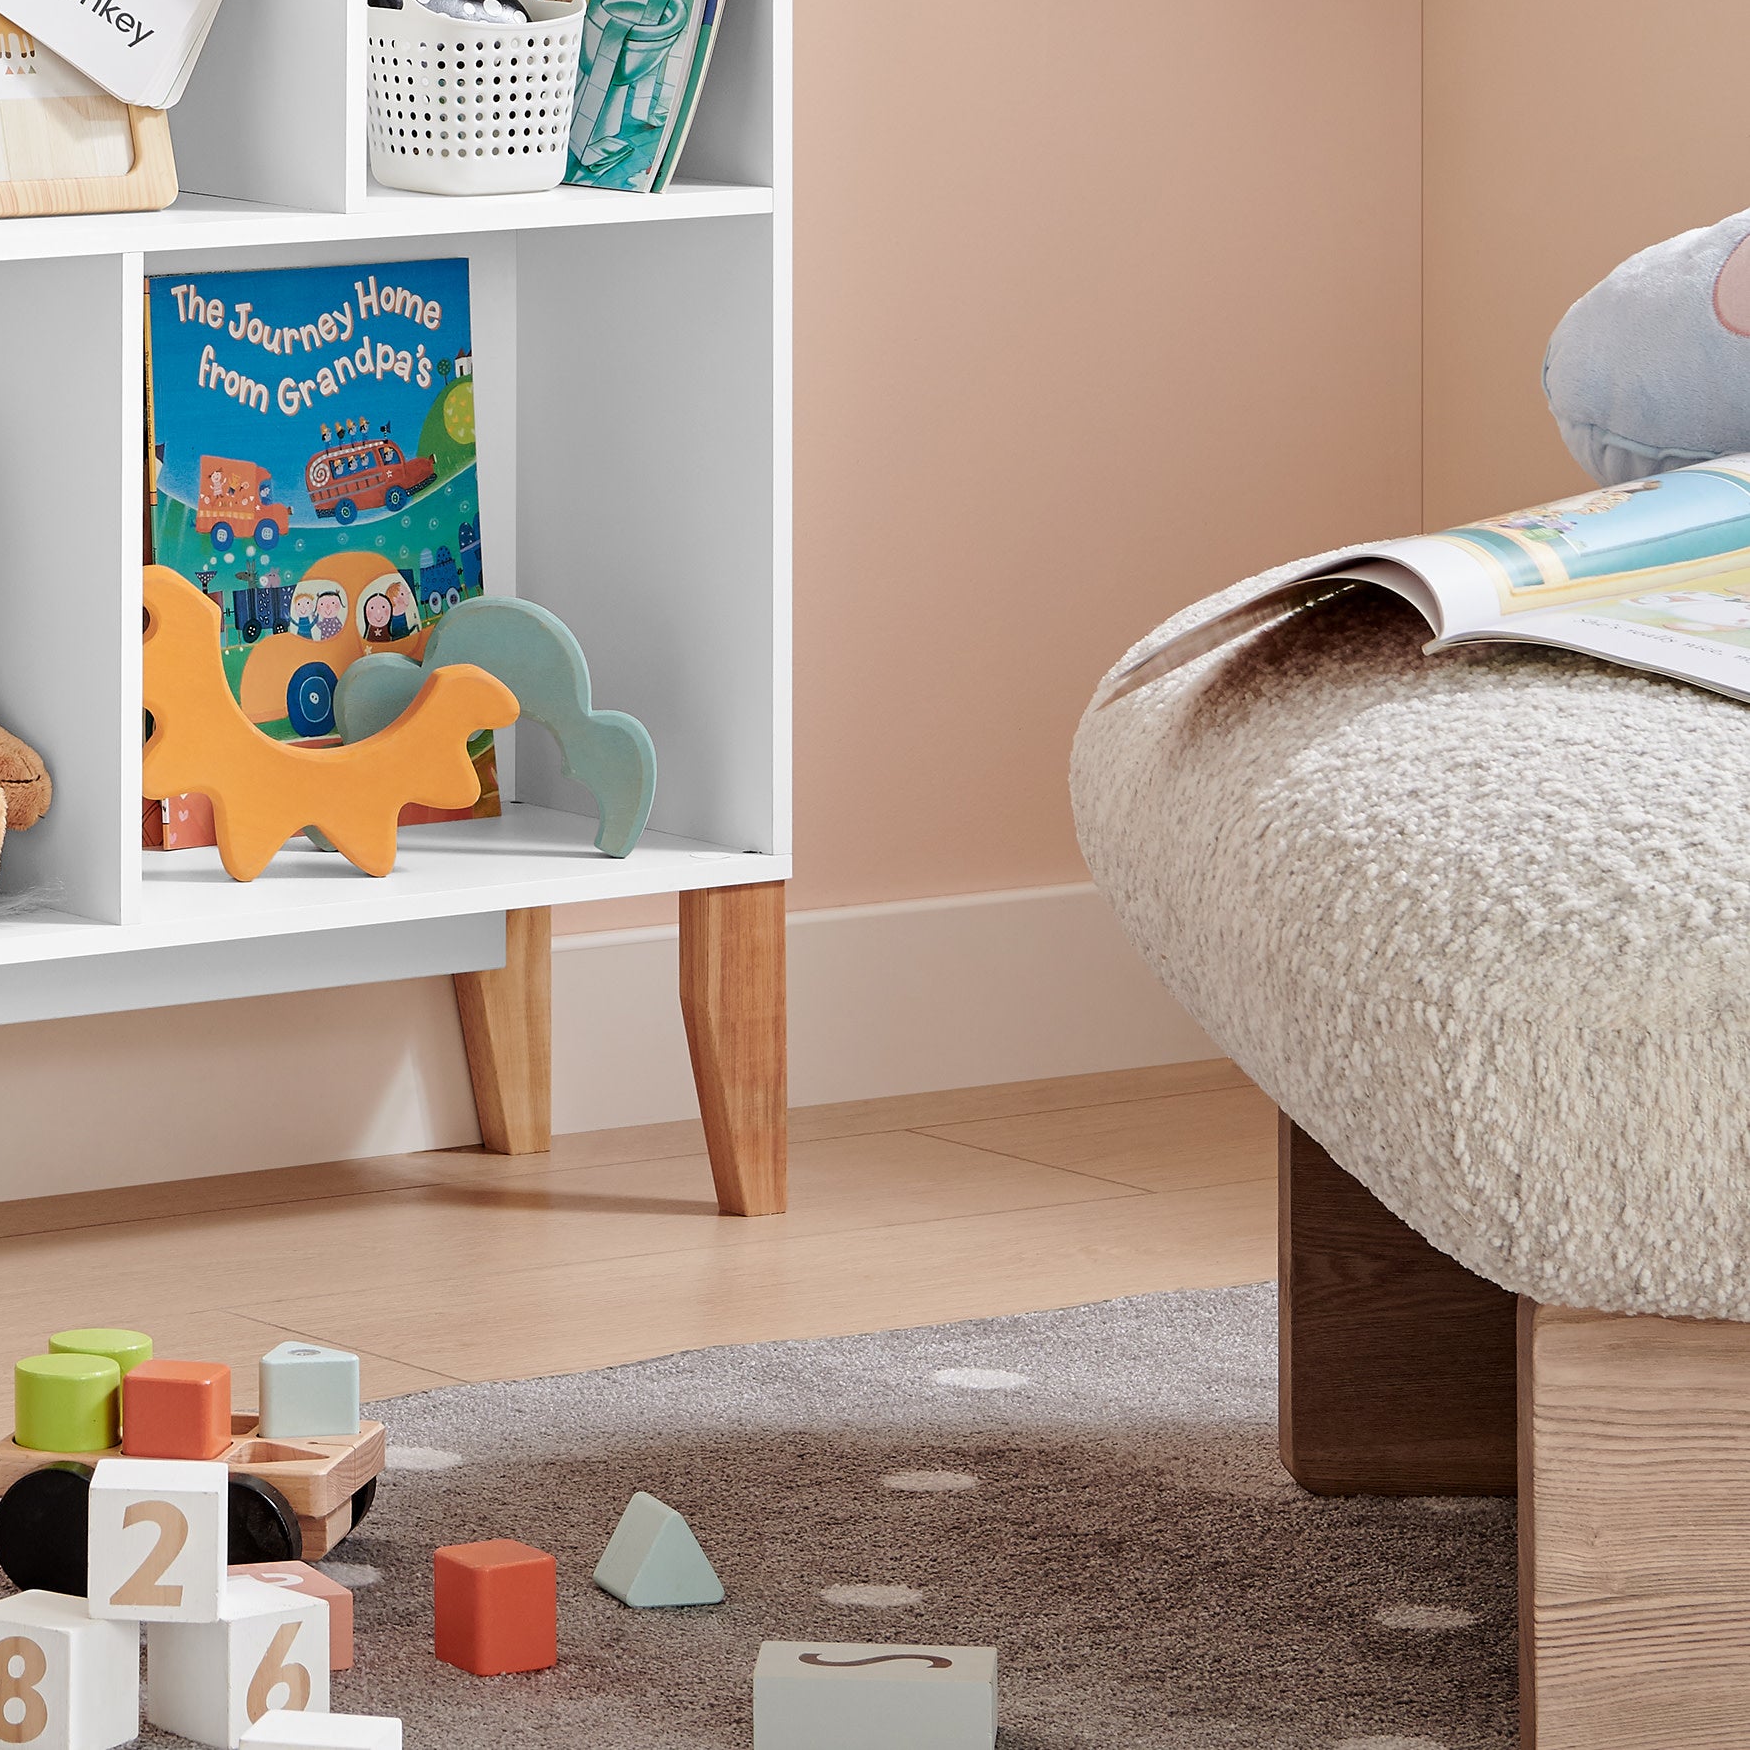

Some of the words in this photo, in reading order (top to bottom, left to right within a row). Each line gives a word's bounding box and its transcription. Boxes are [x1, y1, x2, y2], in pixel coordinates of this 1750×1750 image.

[170, 283, 224, 329] The
[228, 301, 352, 355] Journey
[354, 275, 442, 330] Home
[198, 344, 270, 414] from
[277, 335, 433, 416] Grandpa's
[109, 1499, 189, 1607] 2
[245, 1620, 311, 1725] 6
